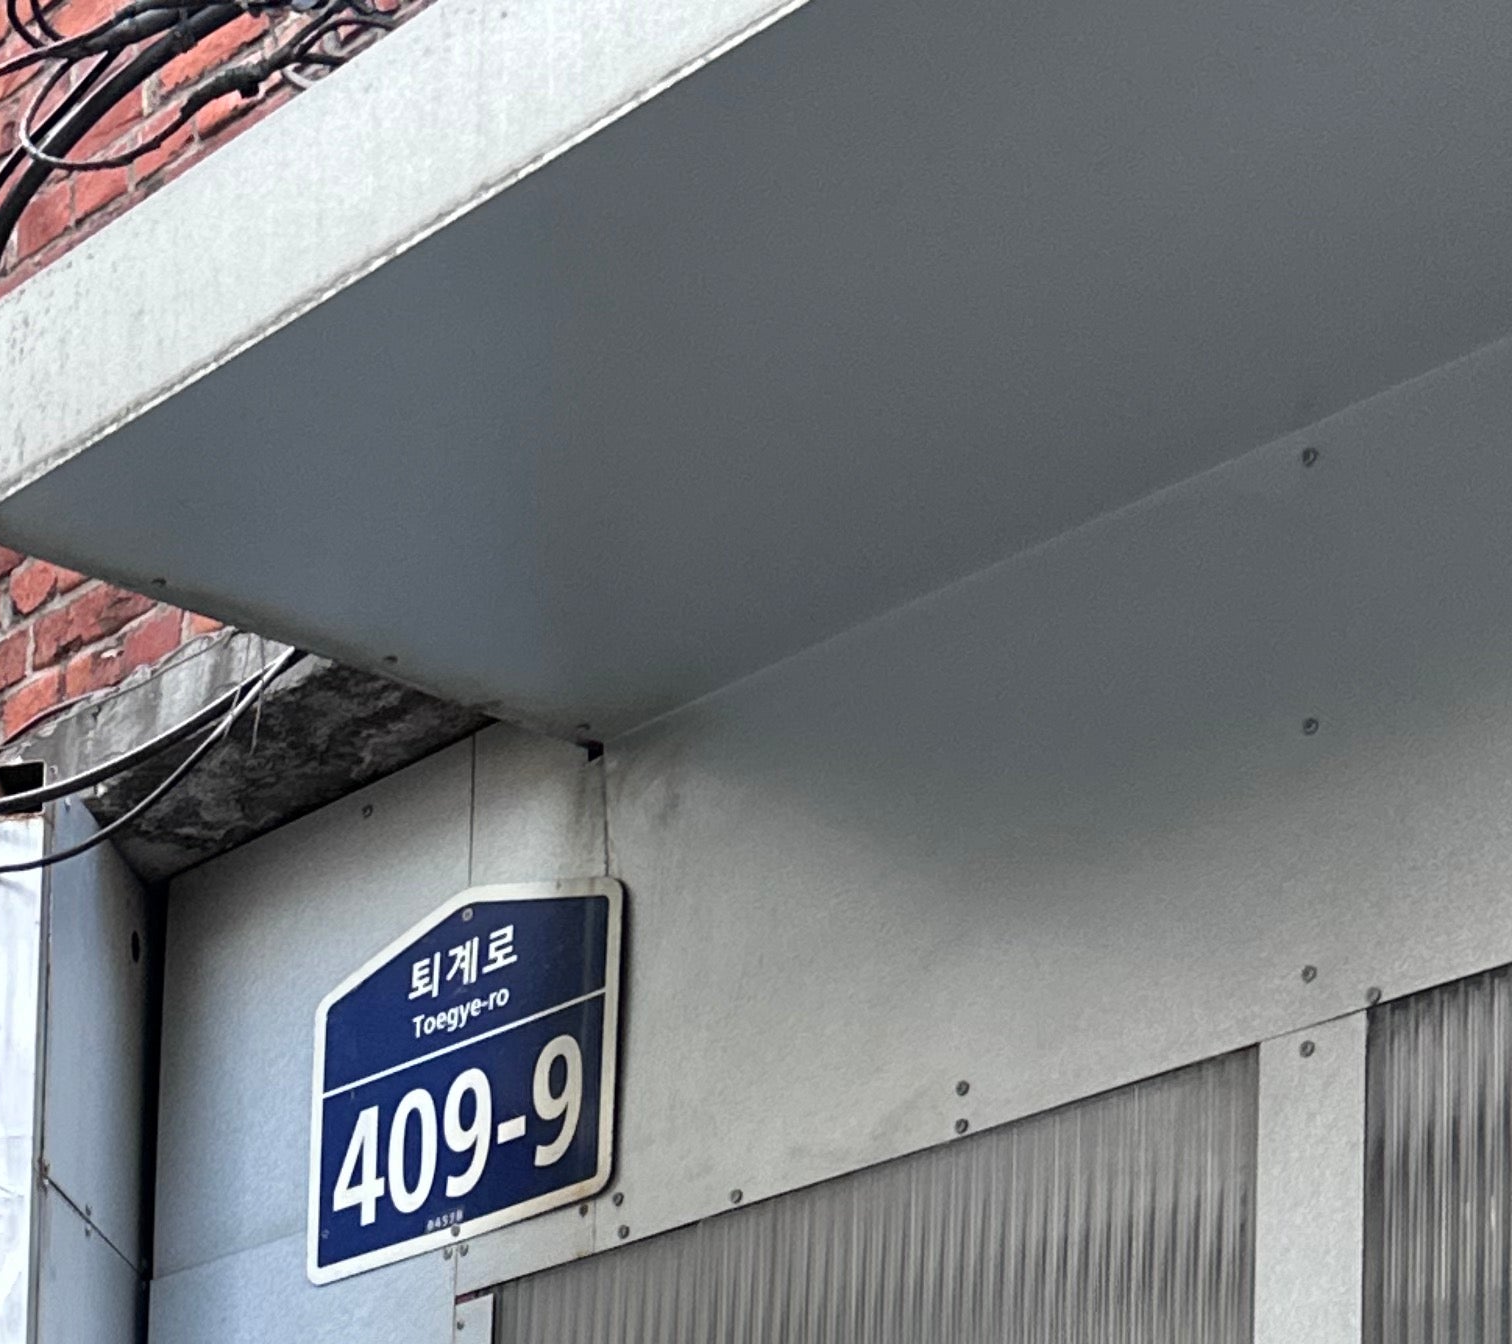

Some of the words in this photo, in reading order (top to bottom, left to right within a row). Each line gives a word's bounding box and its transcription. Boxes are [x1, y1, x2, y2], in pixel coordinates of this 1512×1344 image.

[408, 924, 518, 1001] 퇴계로
[413, 987, 510, 1038] Toegye-ro
[333, 1034, 583, 1227] 409-9
